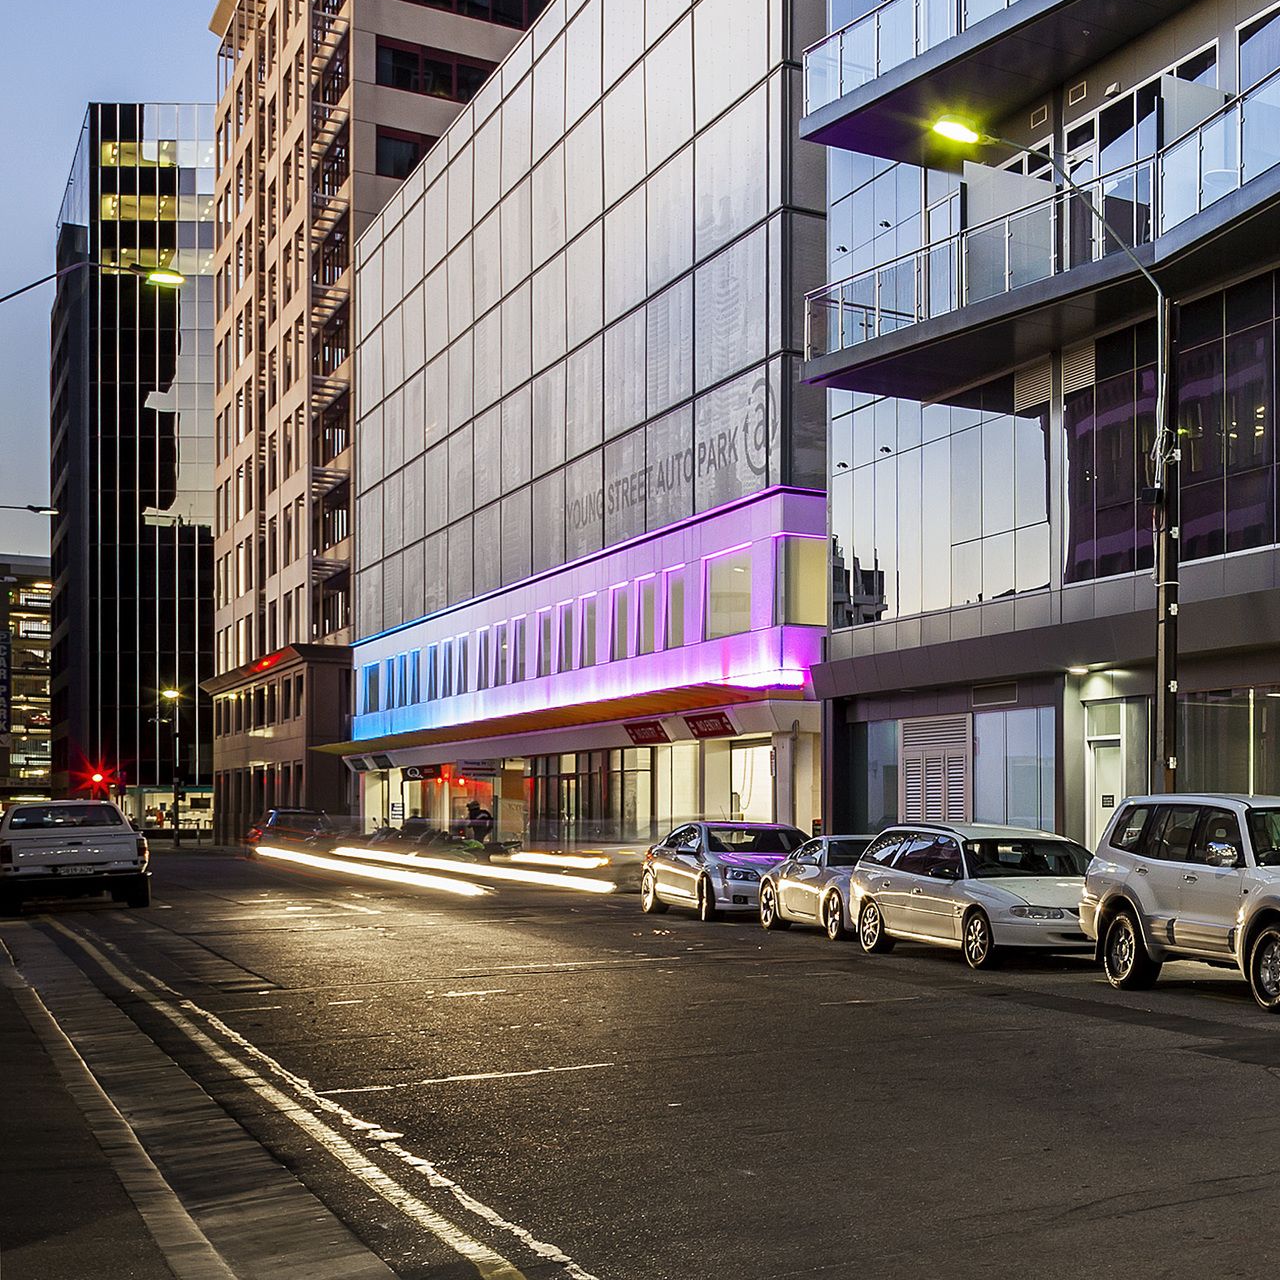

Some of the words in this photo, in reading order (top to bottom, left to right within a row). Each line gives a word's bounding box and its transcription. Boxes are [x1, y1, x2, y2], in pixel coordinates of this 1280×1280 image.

[566, 488, 603, 531] YOUNG
[607, 464, 653, 515] STREET
[656, 448, 694, 494] AUTO
[698, 426, 739, 478] PARK
